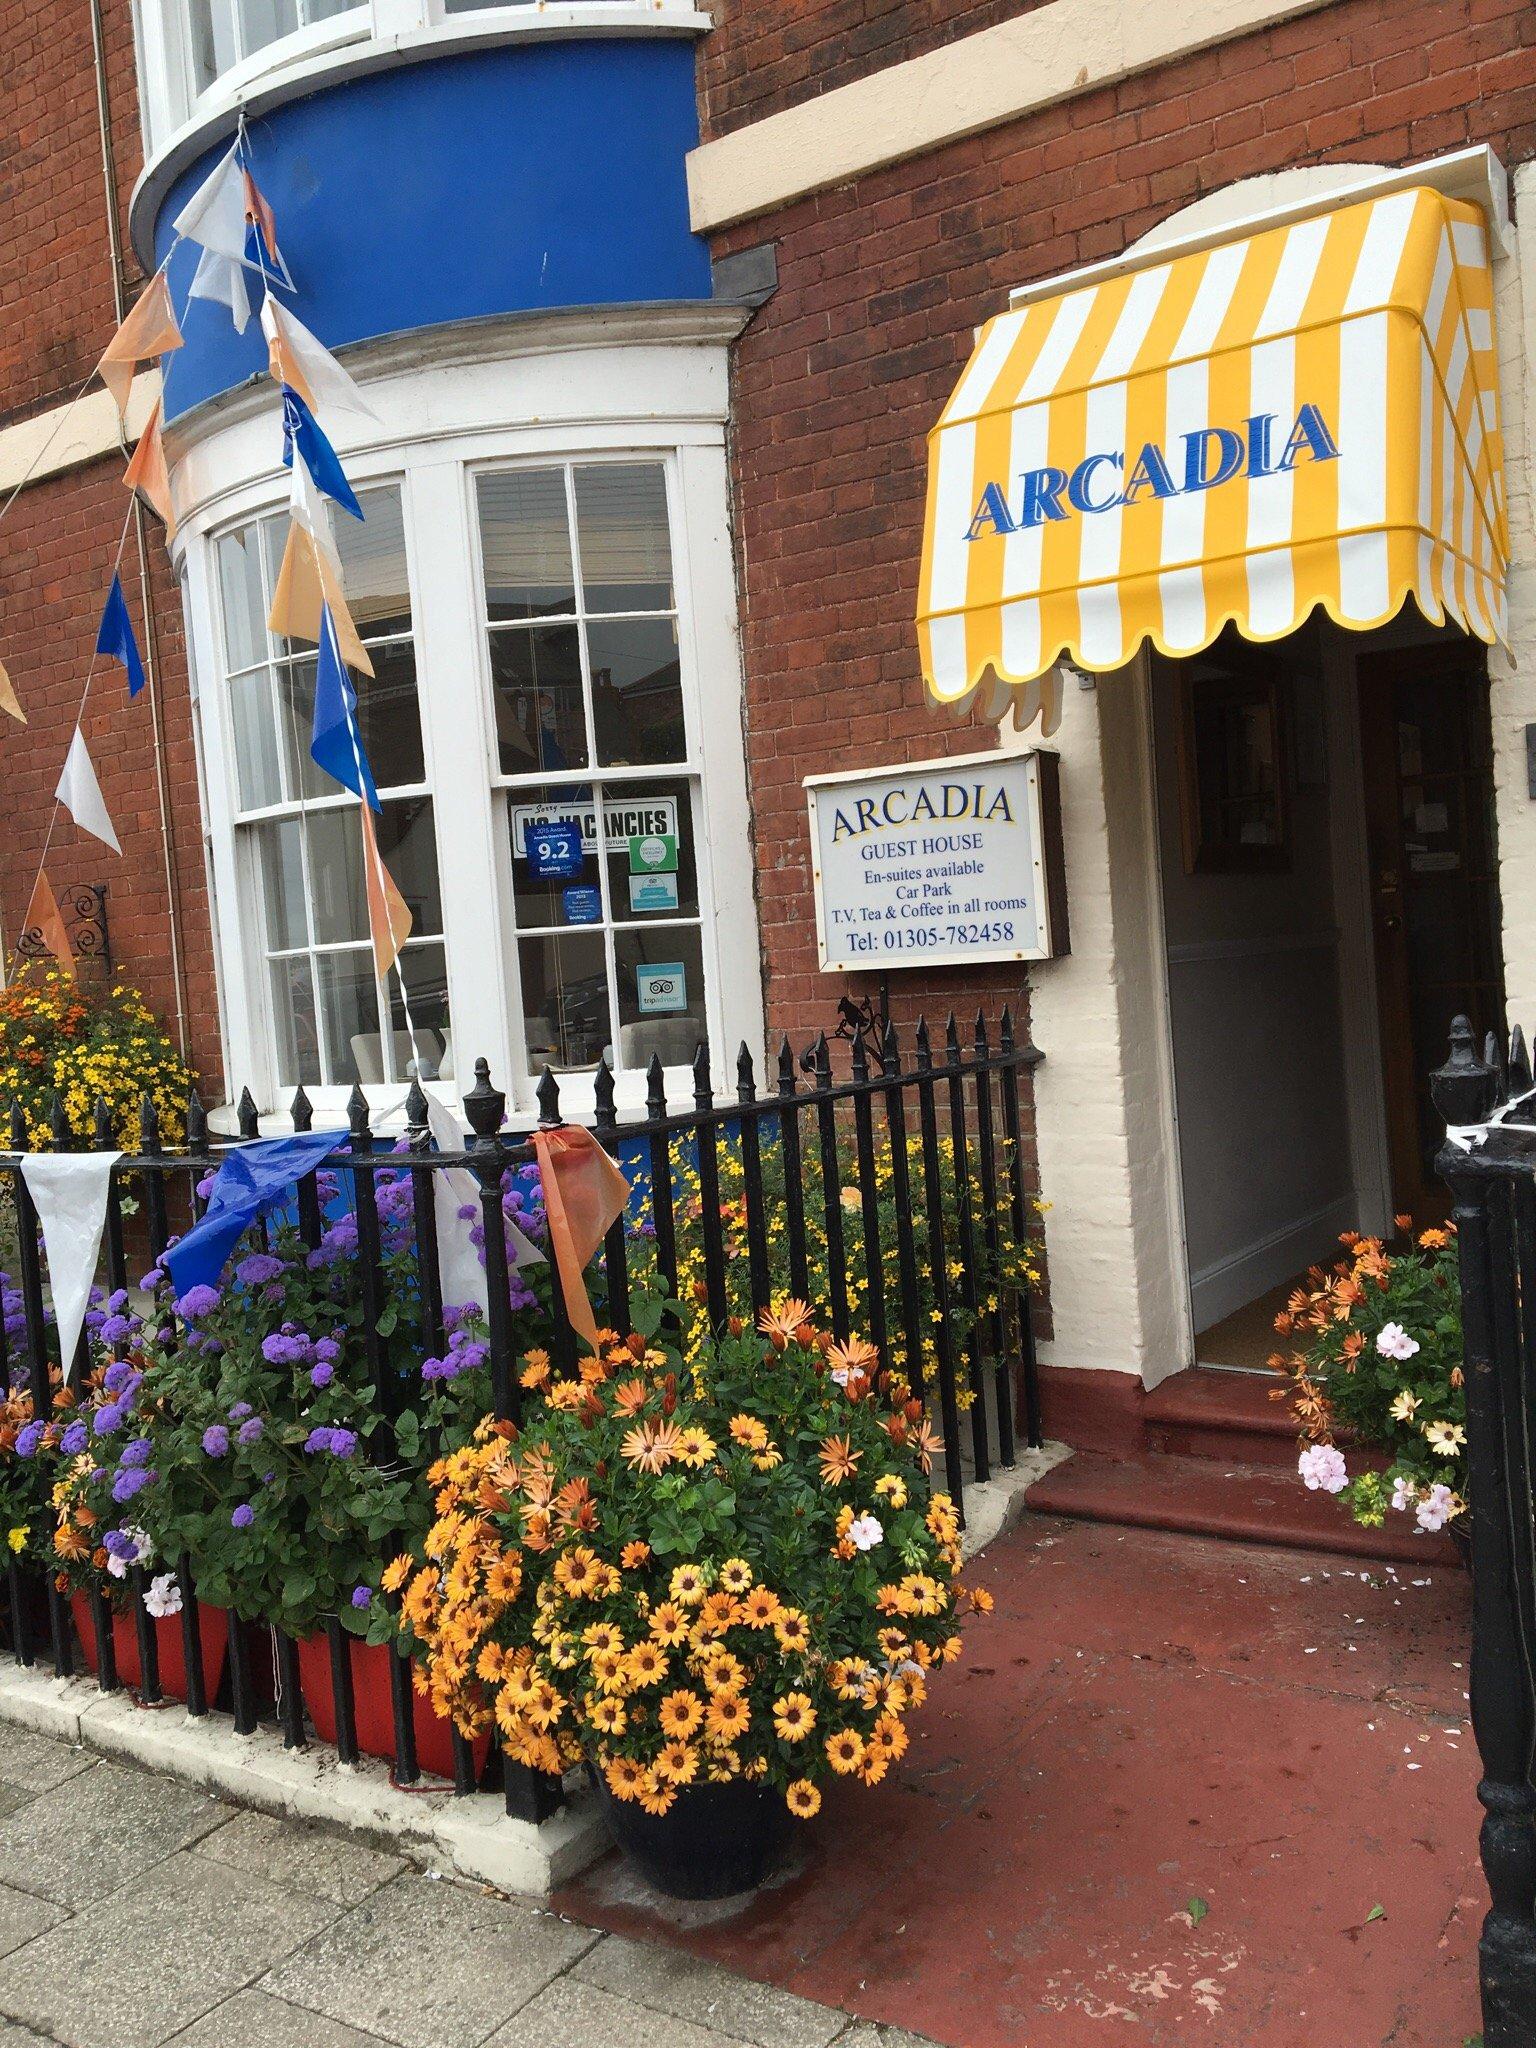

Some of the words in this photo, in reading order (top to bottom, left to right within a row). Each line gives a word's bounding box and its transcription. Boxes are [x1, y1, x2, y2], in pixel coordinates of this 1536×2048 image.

[962, 403, 1342, 541] ARCADIA
[535, 805, 558, 813] Sorry
[832, 784, 1015, 842] ARCADIA
[538, 841, 570, 860] 9.2
[861, 840, 917, 861] GUEST
[922, 833, 983, 855] HOUSE
[865, 867, 922, 884] En-suites
[926, 861, 984, 879] available
[896, 886, 919, 900] Car
[923, 882, 952, 898] Park
[860, 907, 882, 922] Tea
[885, 906, 897, 919] &
[901, 902, 944, 919] Coffee
[948, 900, 960, 915] in
[964, 898, 981, 913] all
[985, 897, 1027, 911] rooms
[847, 931, 878, 951] Tel:
[884, 921, 1015, 950] 01305-782458
